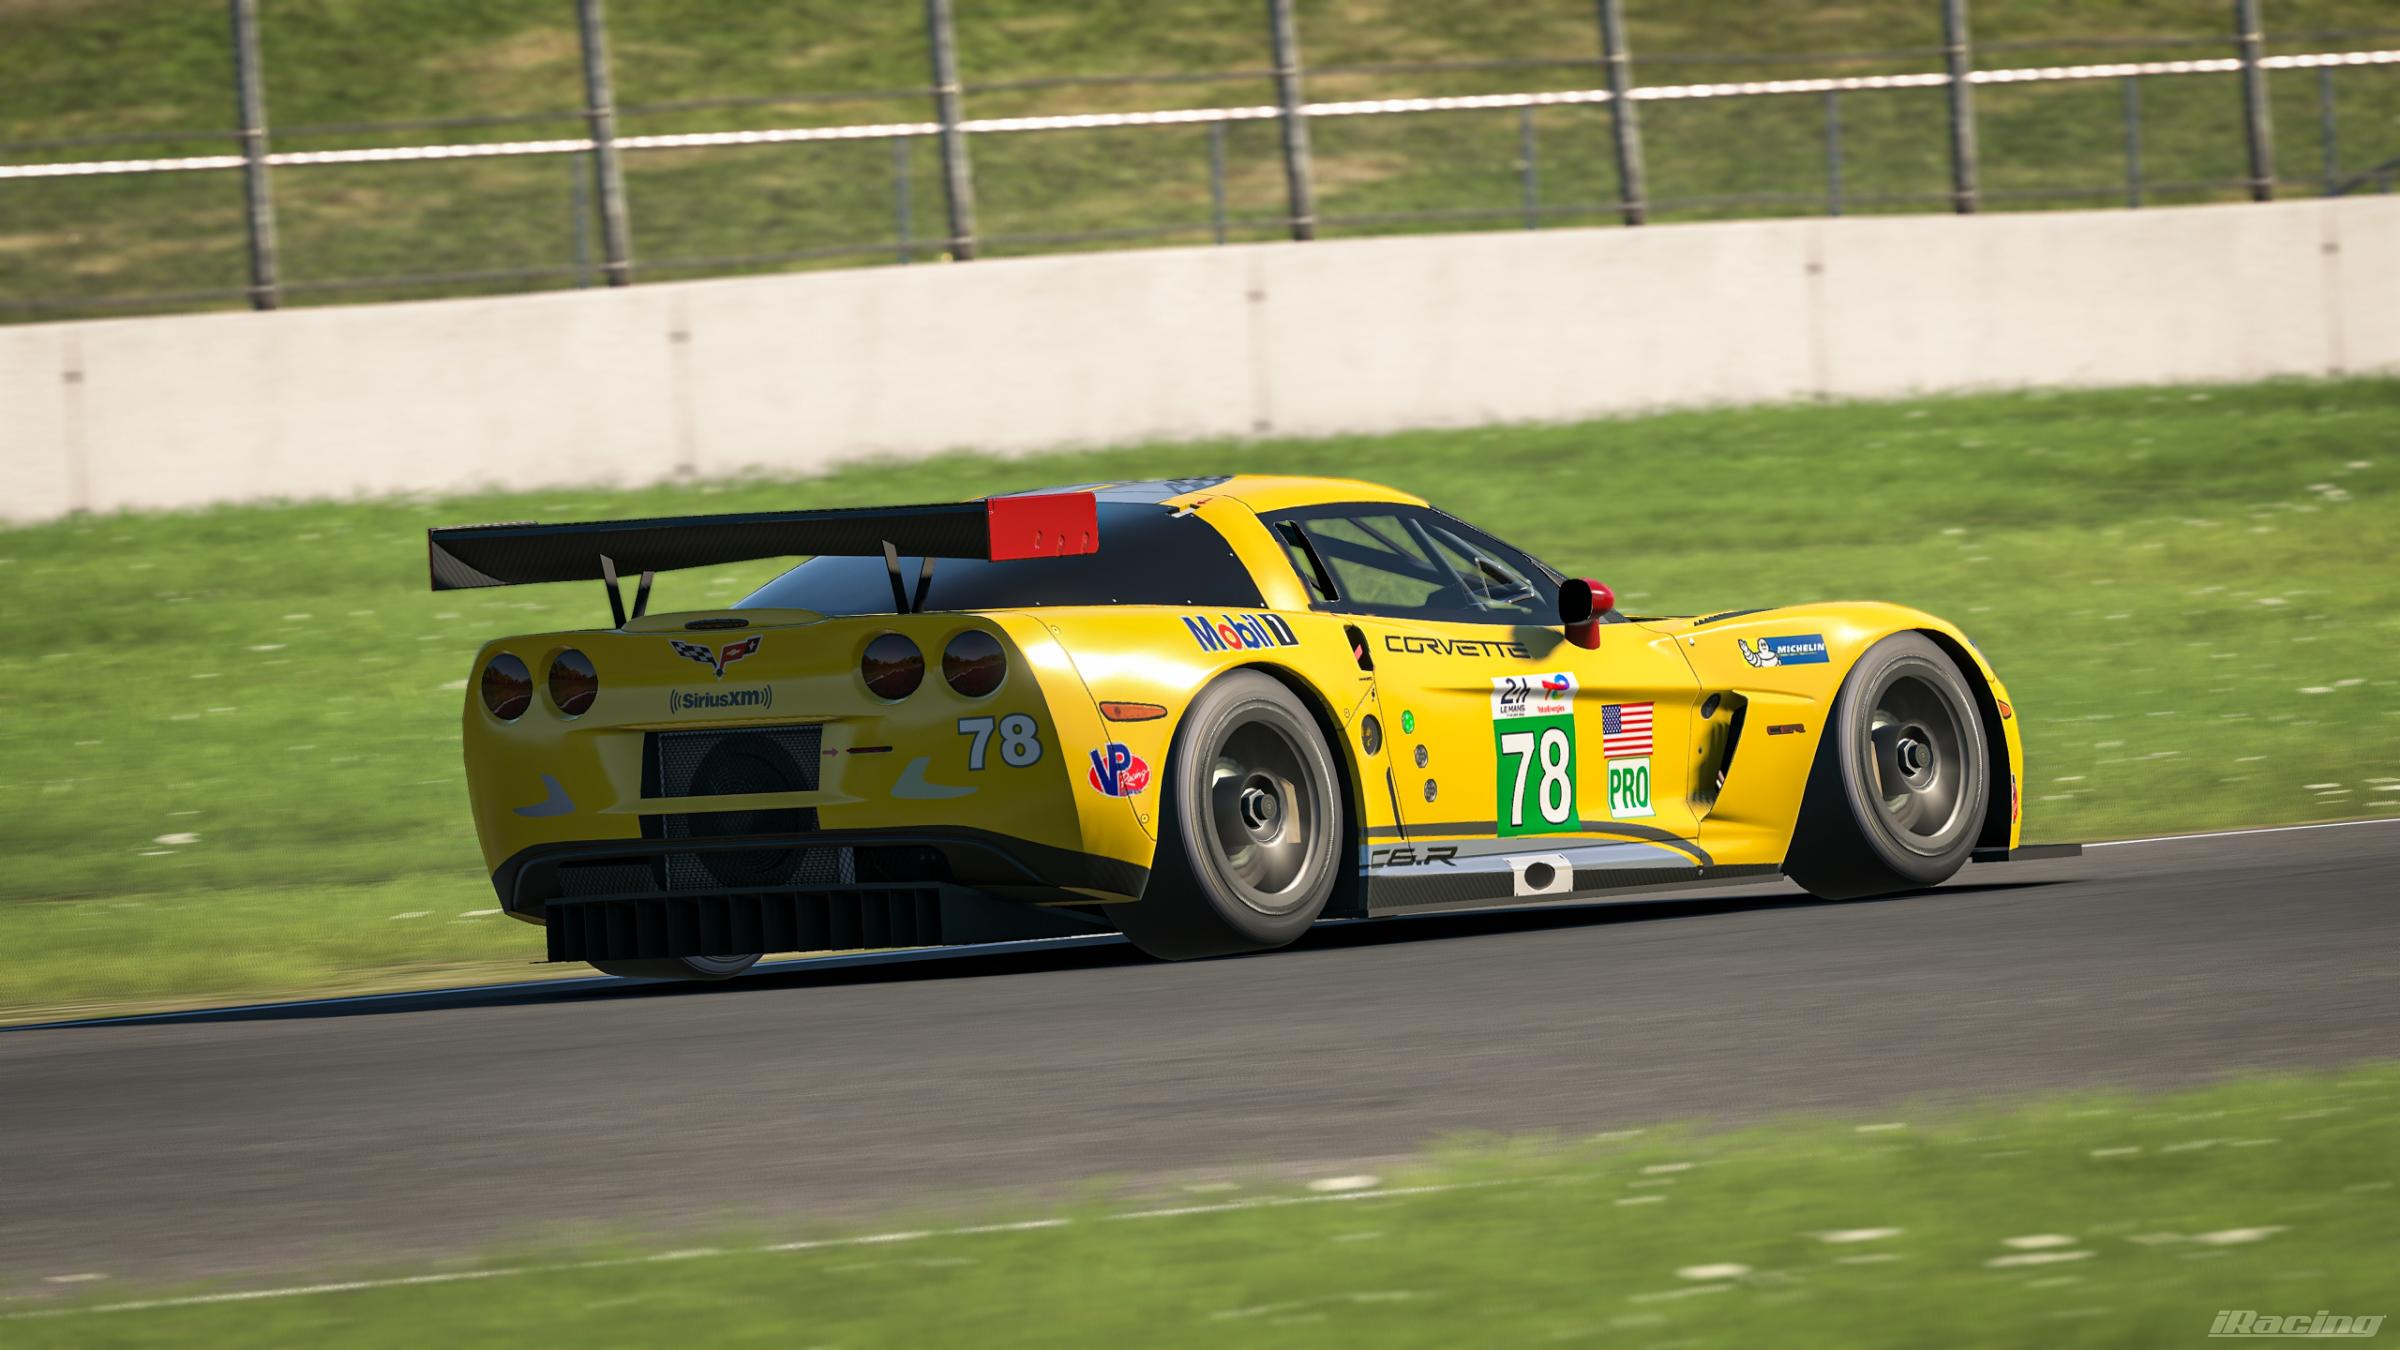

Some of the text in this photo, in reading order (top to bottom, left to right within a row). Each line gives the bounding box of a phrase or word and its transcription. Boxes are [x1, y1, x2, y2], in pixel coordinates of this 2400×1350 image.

[1181, 614, 1295, 652] Mobil 1
[1385, 635, 1531, 658] CORVETTE
[1777, 643, 1825, 654] MICHELIN
[958, 712, 1043, 772] 78
[1090, 744, 1131, 797] VP
[1499, 726, 1572, 827] 78
[1610, 766, 1649, 810] PRO
[1371, 846, 1458, 869] C6.R
